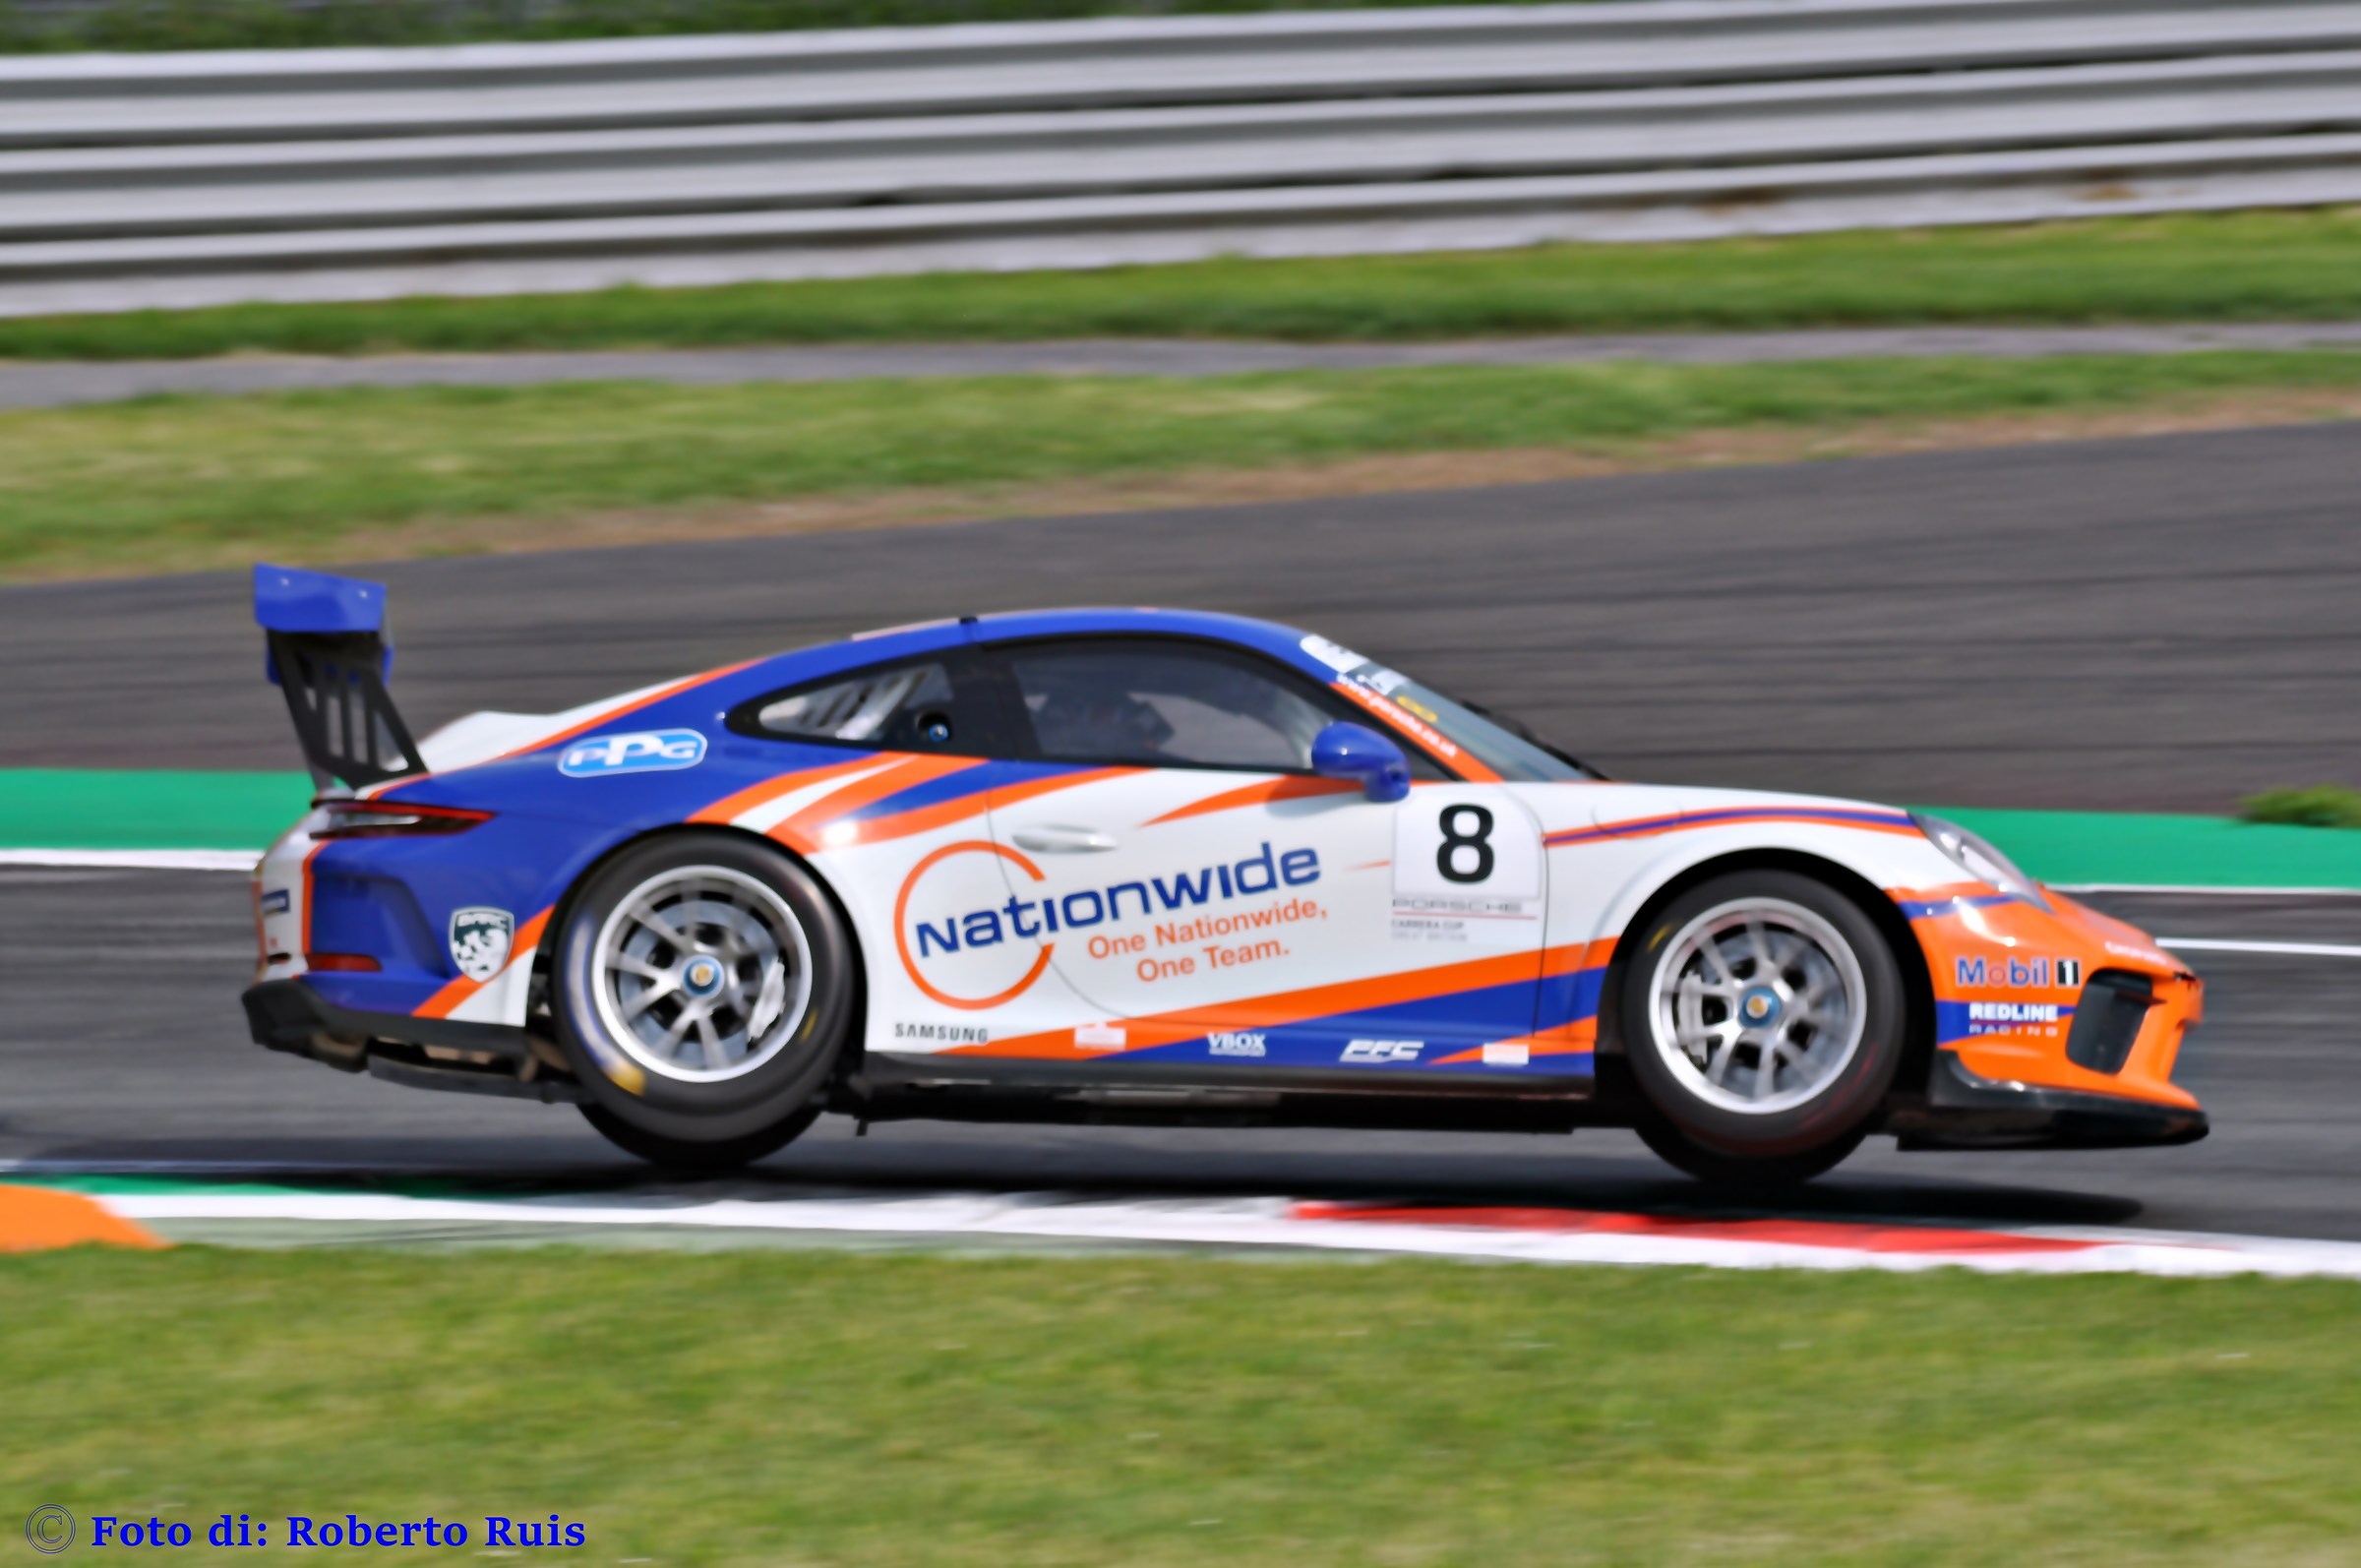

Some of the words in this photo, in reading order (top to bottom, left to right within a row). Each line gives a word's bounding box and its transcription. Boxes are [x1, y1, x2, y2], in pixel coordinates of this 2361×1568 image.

[568, 734, 697, 766] PPG
[1436, 803, 1494, 885] 8
[915, 841, 1321, 958] Nationwide
[1087, 935, 1146, 960] One
[1155, 897, 1328, 946] Nationwide,
[1136, 956, 1195, 983] One
[1208, 939, 1290, 971] Team.
[1956, 958, 2049, 987] Mobil
[1969, 1001, 2058, 1022] REDLINE
[894, 1022, 989, 1045] SAMSUNG
[1208, 1032, 1266, 1052] VBOX
